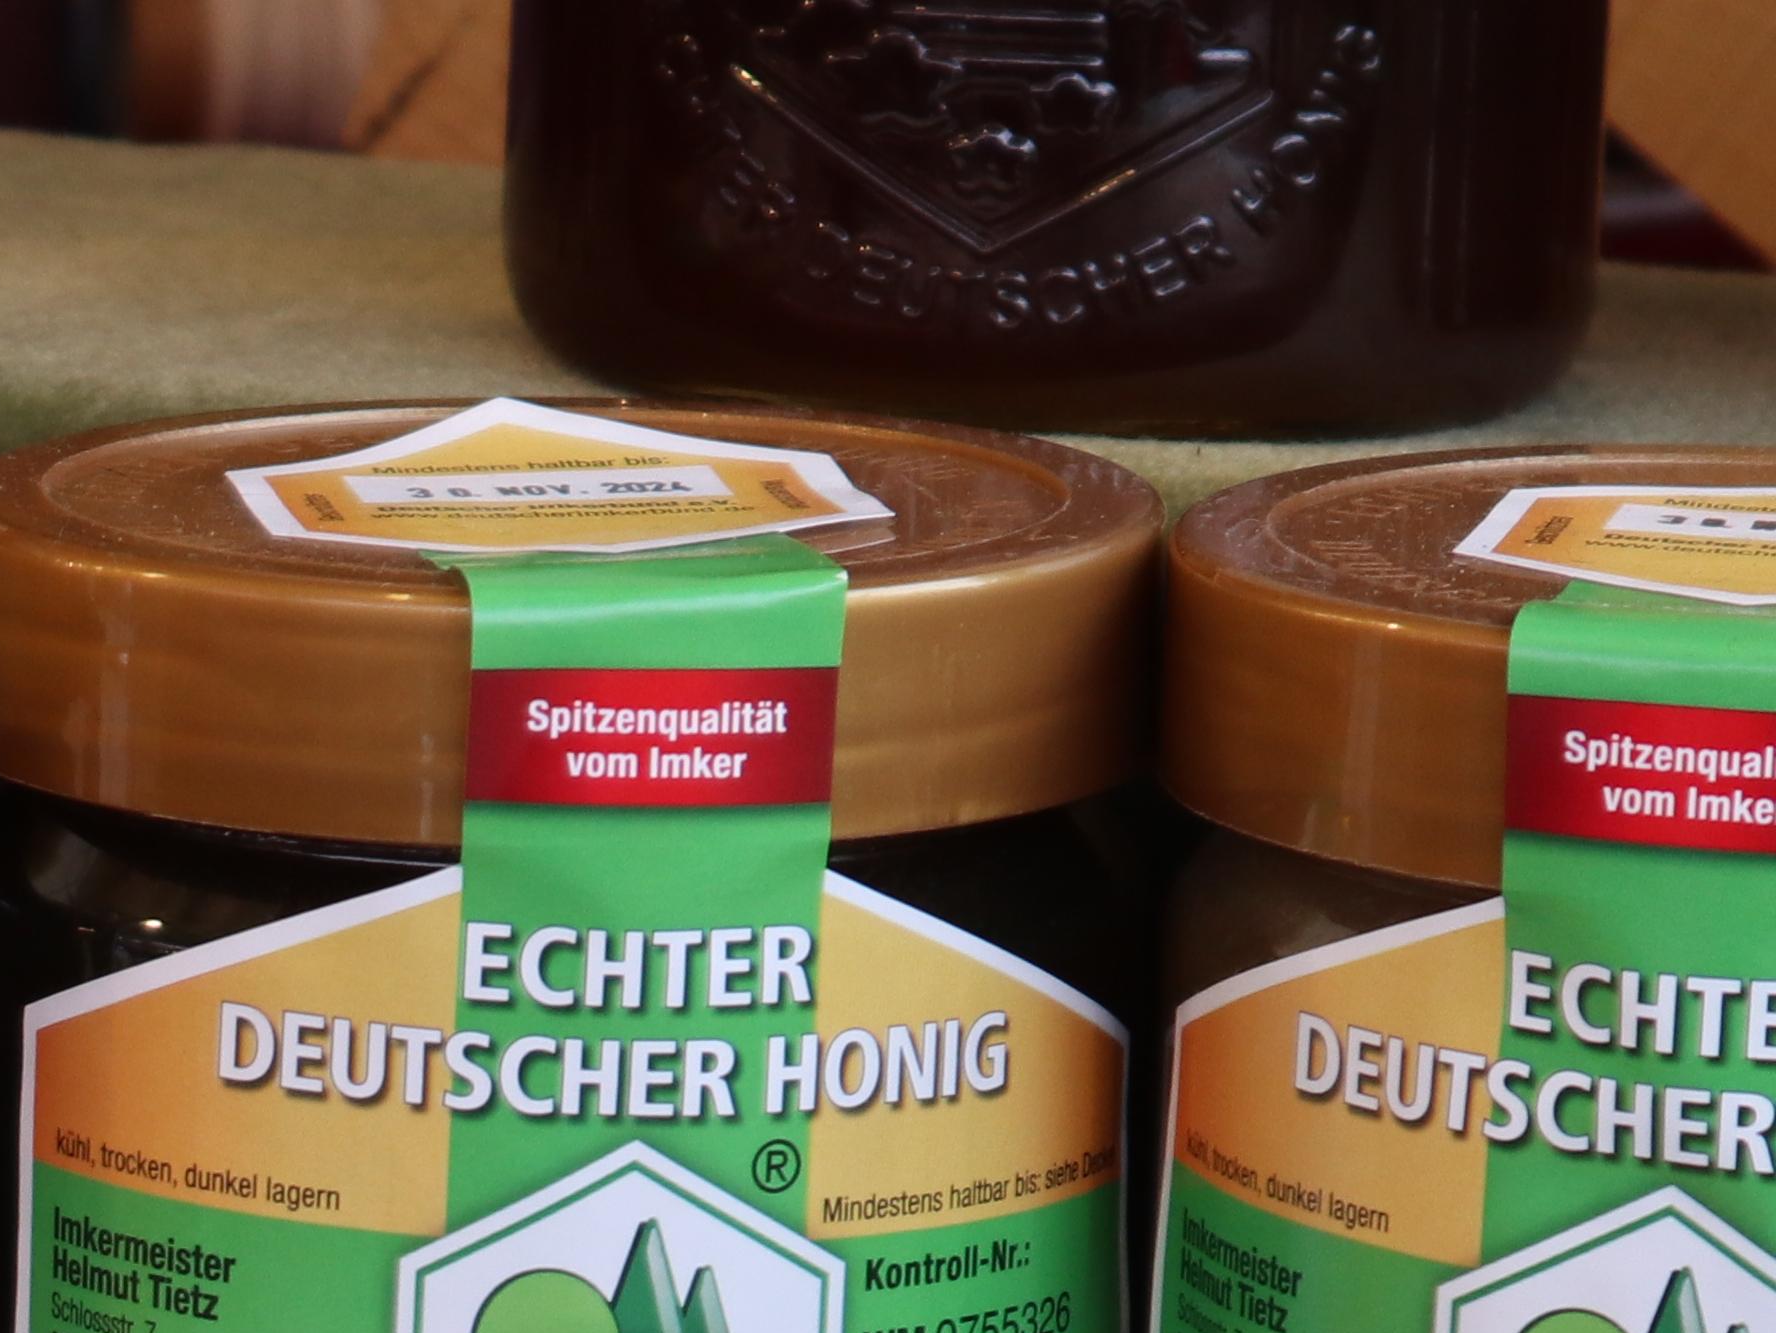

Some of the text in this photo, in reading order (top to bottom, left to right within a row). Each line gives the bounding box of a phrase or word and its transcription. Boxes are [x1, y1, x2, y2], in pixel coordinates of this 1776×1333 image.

[527, 696, 787, 740] Spitzenqualität
[566, 746, 747, 779] vom Imker
[1564, 730, 1776, 783] Spitzenqual
[1602, 785, 1776, 825] vom Imke
[463, 922, 813, 1009] ECHTER
[1508, 949, 1776, 1062] ECHTE
[217, 1000, 1010, 1119] DEUTSCHER HONIG
[1293, 1010, 1774, 1175] DEUTSCHER
[55, 1128, 341, 1211] kühl, trocken, dunkel lagern
[822, 1157, 1081, 1225] Mindestens haltbar bis: siehe
[1266, 1173, 1389, 1232] dunkel lagern
[53, 1205, 236, 1284] Imkermeister
[865, 1243, 1031, 1292] Kontroll-Nr.:
[1180, 1247, 1232, 1310] Helmut
[1182, 1209, 1302, 1297] Imkermeister
[52, 1244, 220, 1322] Helmut Tietz
